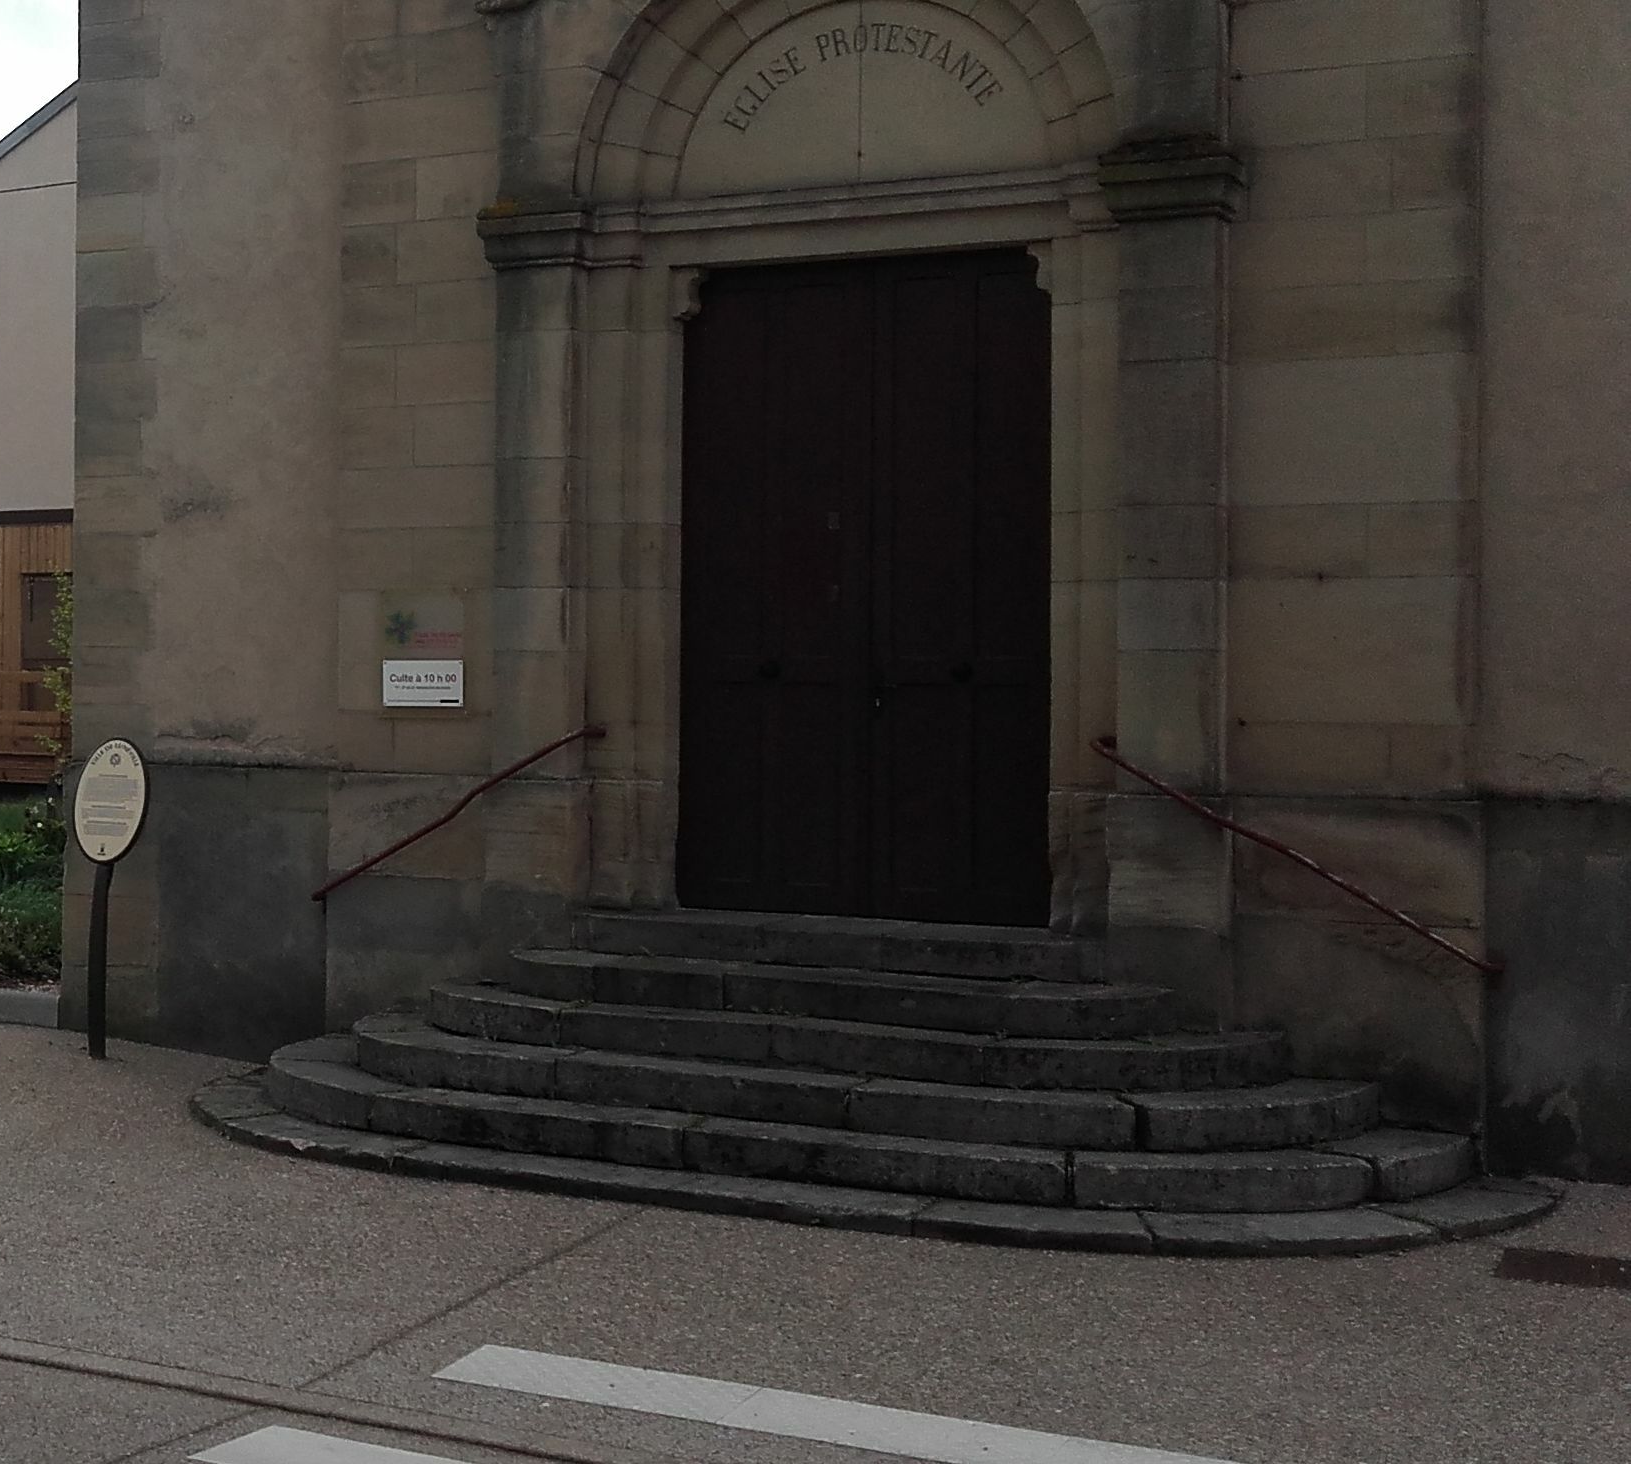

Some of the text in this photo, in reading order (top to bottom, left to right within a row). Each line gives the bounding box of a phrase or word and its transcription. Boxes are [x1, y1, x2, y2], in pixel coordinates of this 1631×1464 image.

[723, 23, 1004, 133] EGLISE PROTESTANTE
[389, 673, 414, 683] Culte
[424, 673, 435, 683] 10
[437, 673, 443, 683] h
[445, 673, 457, 683] 00
